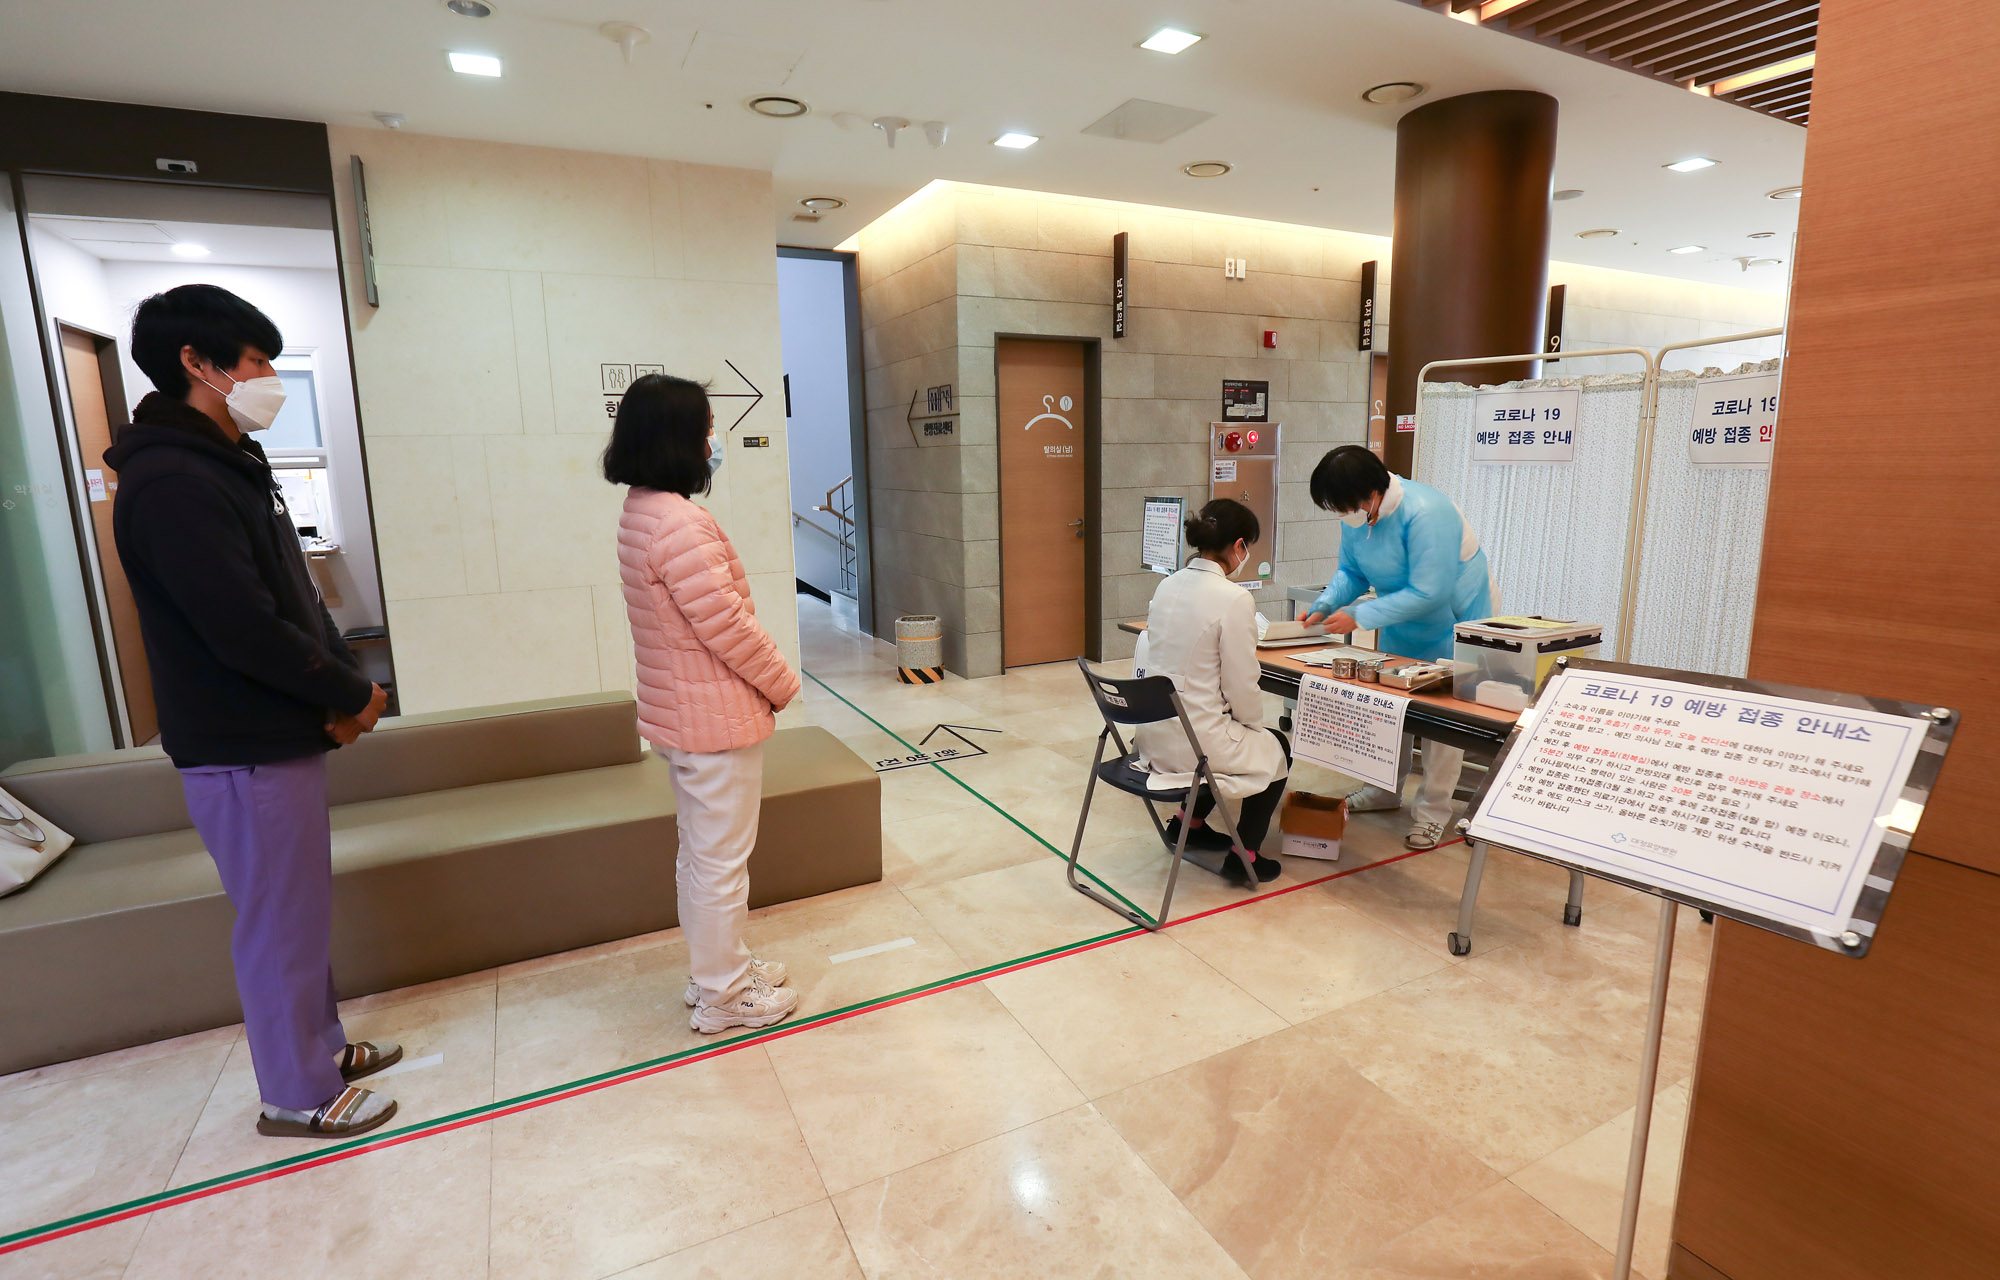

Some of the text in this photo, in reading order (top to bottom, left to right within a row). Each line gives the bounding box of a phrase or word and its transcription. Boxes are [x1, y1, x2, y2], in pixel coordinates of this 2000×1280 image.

[1550, 335, 1561, 352] 9
[1493, 407, 1561, 423] 코로나 19
[1711, 396, 1777, 416] 코로나 19
[1476, 429, 1572, 445] 예방 접종 안내
[1692, 424, 1774, 445] 예방 접종 안
[1309, 681, 1395, 709] 코로나 19 예방 접종 안내소
[1564, 702, 1588, 712] 소속과
[1590, 707, 1614, 716] 이름을
[1617, 711, 1651, 722] 이야기해
[1654, 717, 1680, 727] 주세요
[1580, 683, 1871, 742] 코로나 19 예방 접종 안내소
[1549, 728, 1572, 738] 주세요
[1604, 719, 1630, 729] 호흡기
[1632, 724, 1650, 732] 증상
[1677, 732, 1696, 741] 오늘
[1700, 736, 1739, 749] 컨디션에
[1742, 744, 1773, 755] 대하여
[1777, 750, 1810, 763] 이야기
[1814, 758, 1826, 766] 해
[1830, 760, 1864, 773] 주세요
[1543, 737, 1560, 746] 예진
[1573, 743, 1590, 752] 예방
[1672, 763, 1691, 773] 예방
[1695, 768, 1723, 779] 접종후
[1728, 775, 1769, 790] 이상반응
[1773, 785, 1795, 796] 관찰
[1800, 791, 1845, 806] 장소에서
[1553, 719, 1585, 730] 예진표를
[1587, 726, 1604, 734] 받고
[1614, 731, 1632, 739] 예진
[1634, 734, 1661, 745] 의사님
[1664, 740, 1683, 749] 진료
[1700, 747, 1720, 756] 예방
[1723, 751, 1743, 761] 접종
[1747, 756, 1758, 764] 전
[1762, 759, 1784, 769] 대기
[1788, 764, 1831, 779] 장소에서
[1836, 774, 1871, 787] 대기해
[1539, 747, 1799, 809] 15분간 의무 대기 하시고 한방외래 확인후 업무 복귀해 주세요
[1540, 757, 1586, 773] 아나필락시스
[1590, 768, 1616, 779] 병력이
[1618, 774, 1636, 784] 있는
[1639, 779, 1667, 791] 사람은
[1670, 786, 1693, 797] 30분
[1696, 791, 1717, 802] 관찰
[1720, 797, 1741, 808] 필요
[1511, 793, 1570, 813] 주시기 바랍니다
[1523, 775, 1771, 841] 1차 예방 접종했던 의료기관에서 접종 하시기를 권고 합니다
[1528, 765, 1544, 774] 예방
[1546, 769, 1570, 780] 접종은
[1678, 799, 1698, 809] 후에
[1785, 825, 1807, 836] 예정
[1517, 784, 1533, 793] 접종
[1547, 791, 1563, 800] 에도
[1566, 796, 1591, 807] 마스크
[1618, 808, 1646, 821] 올바른
[1692, 827, 1712, 838] 개인
[1717, 833, 1737, 845] 위생
[1742, 841, 1774, 855] 수칙을
[1779, 850, 1813, 864] 반드시
[1818, 860, 1841, 872] 지켜
